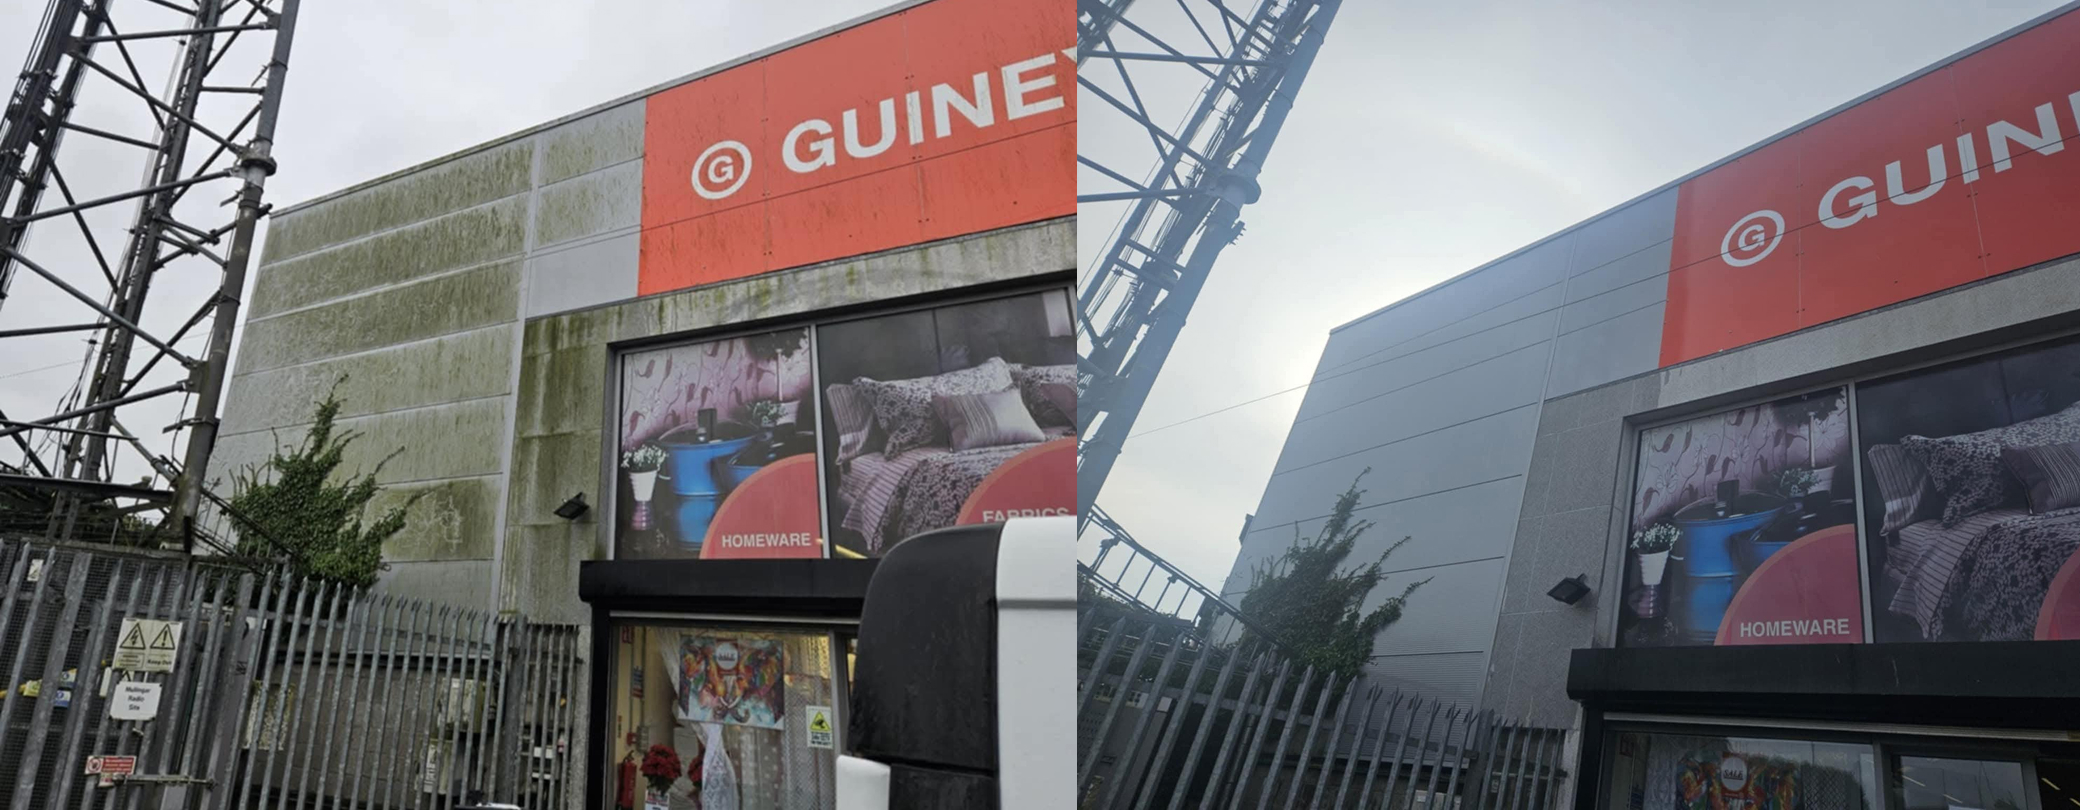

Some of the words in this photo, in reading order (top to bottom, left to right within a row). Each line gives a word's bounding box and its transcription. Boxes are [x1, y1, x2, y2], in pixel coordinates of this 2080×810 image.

[707, 155, 734, 184] G
[782, 47, 1077, 173] GUINE
[1737, 224, 1765, 252] G
[1817, 90, 2080, 229] GUIN
[722, 533, 811, 548] HOMEWARE
[1740, 618, 1850, 637] HOMEWARE
[125, 686, 151, 694] Mullingar
